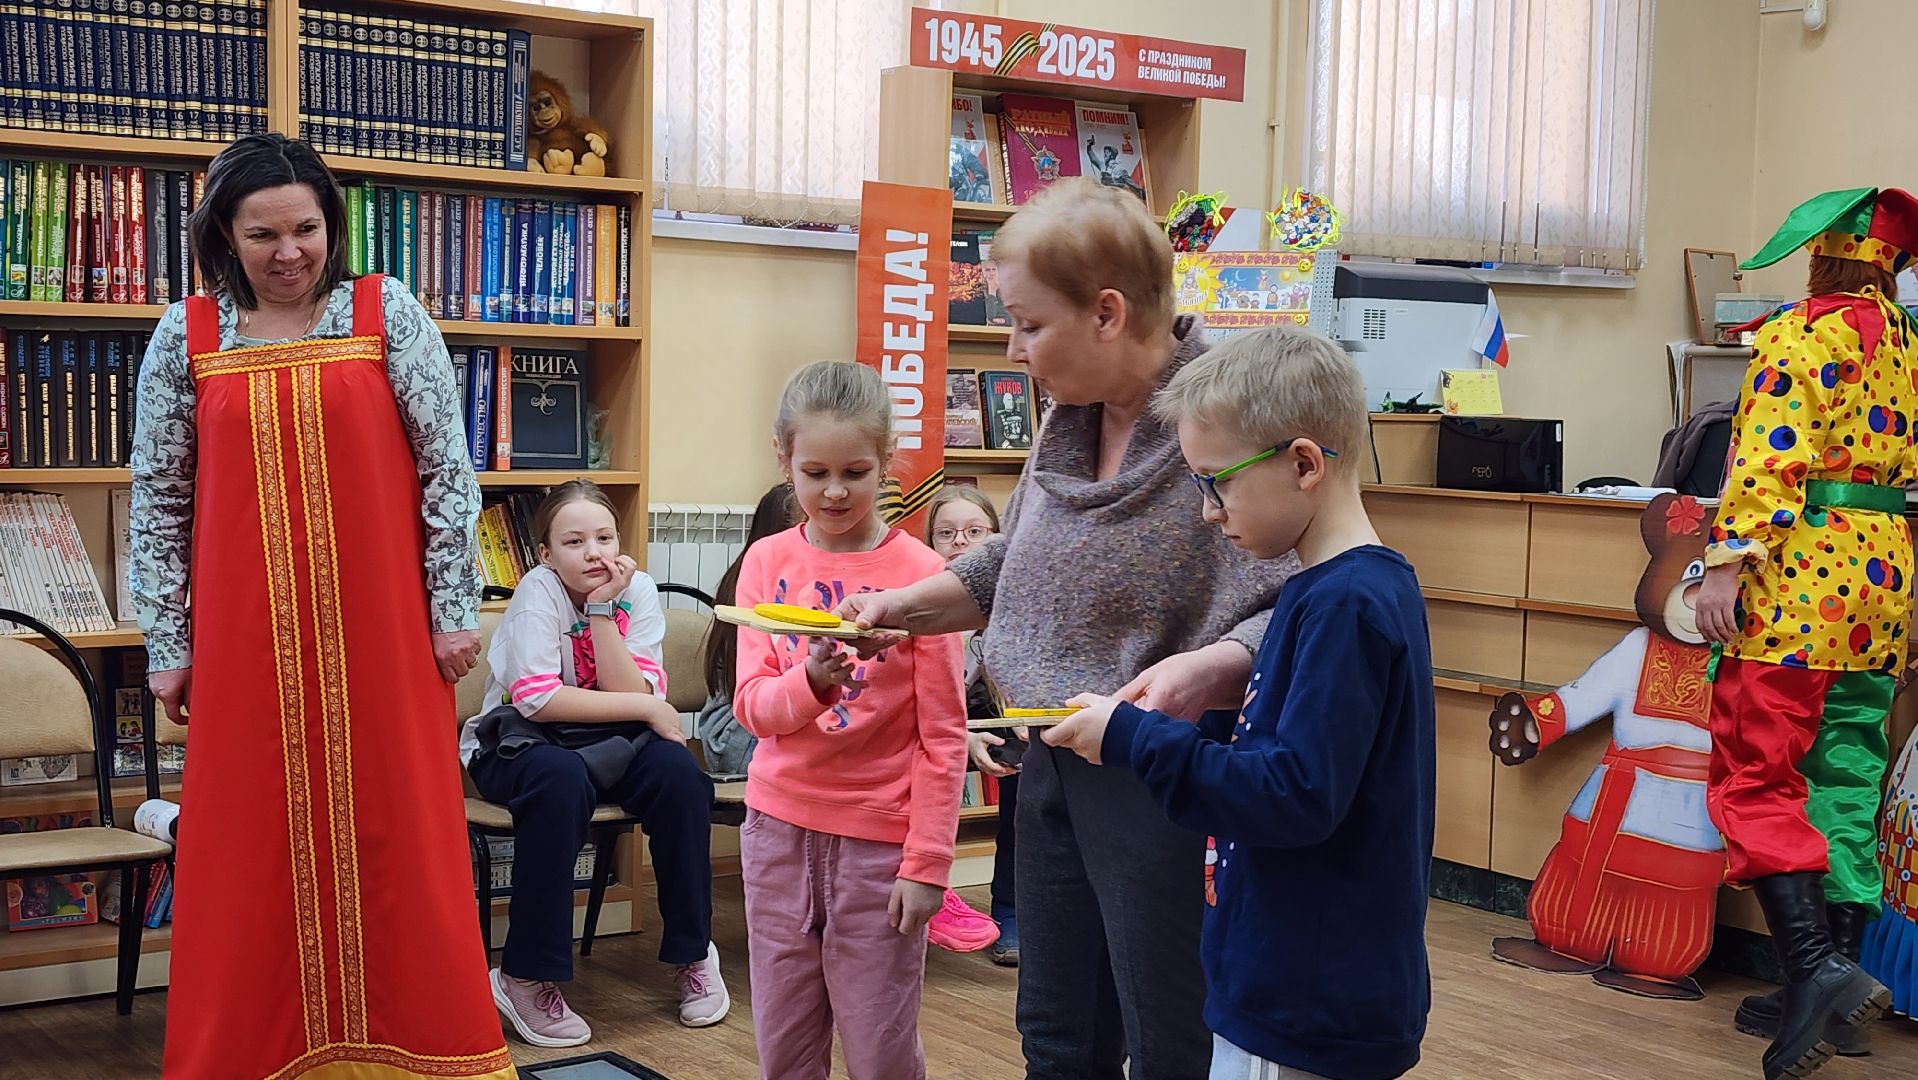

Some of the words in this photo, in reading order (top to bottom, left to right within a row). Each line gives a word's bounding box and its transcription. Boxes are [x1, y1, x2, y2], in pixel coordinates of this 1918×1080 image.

[925, 18, 1002, 68] 1945
[1037, 31, 1115, 81] 2025
[1138, 49, 1146, 62] С
[1148, 50, 1212, 71] ПРАЗДНИКОМ
[1138, 66, 1181, 83] ВЕЛИКОЙ
[1183, 70, 1226, 89] ПОБЕДЫ!
[32, 100, 38, 109] 8
[50, 102, 56, 110] 9
[68, 104, 77, 112] 10
[139, 109, 148, 118] 15
[156, 110, 165, 118] 14
[174, 112, 183, 120] 16
[190, 111, 199, 119] 17
[207, 114, 216, 122] 18
[224, 114, 233, 122] 19
[1082, 109, 1129, 126] ПОМНИМ!
[240, 116, 249, 124] 20
[327, 127, 336, 135] 24
[359, 131, 368, 139] 26
[374, 131, 383, 139] 27
[389, 132, 398, 140] 28
[419, 136, 428, 144] 30
[480, 141, 488, 149] 34
[495, 142, 503, 150] 35
[179, 181, 187, 207] ДЕТЕЙ
[180, 211, 188, 227] ДЛЯ
[519, 223, 528, 287] ИНФОРМАТИКА
[536, 236, 544, 273] ЧЕЛОВЕК
[180, 230, 189, 298] ЭНЦИКЛОПЕДИЯ
[881, 228, 934, 449] ПОБЕДА!
[511, 354, 580, 374] КНИГА
[109, 375, 117, 395] ДЕТЕЙ
[993, 380, 1022, 395] ЖУКОВ
[476, 399, 487, 457] ОТЕЧЕСТВО
